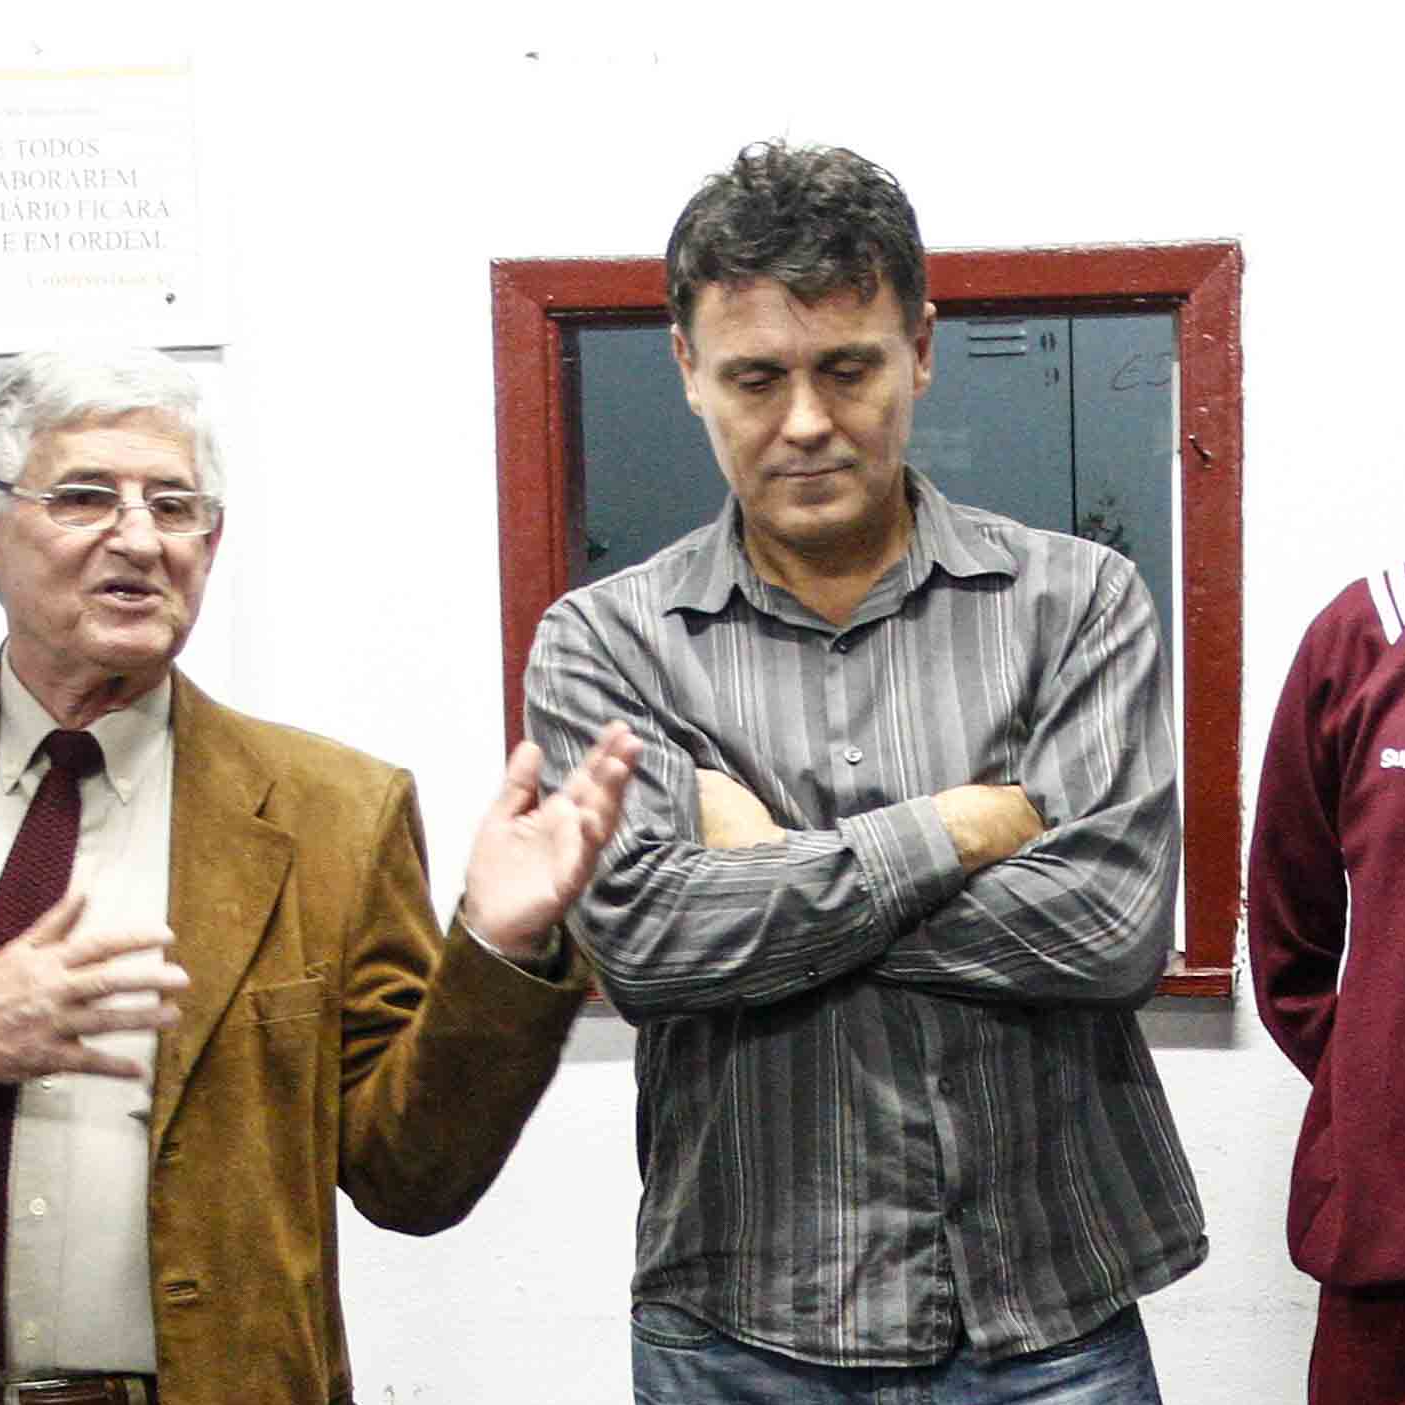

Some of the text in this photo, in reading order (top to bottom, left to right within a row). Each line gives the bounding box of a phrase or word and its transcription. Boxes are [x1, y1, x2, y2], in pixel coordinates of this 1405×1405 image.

[15, 136, 100, 160] TODOS
[2, 232, 18, 254] E
[23, 231, 61, 253] EM
